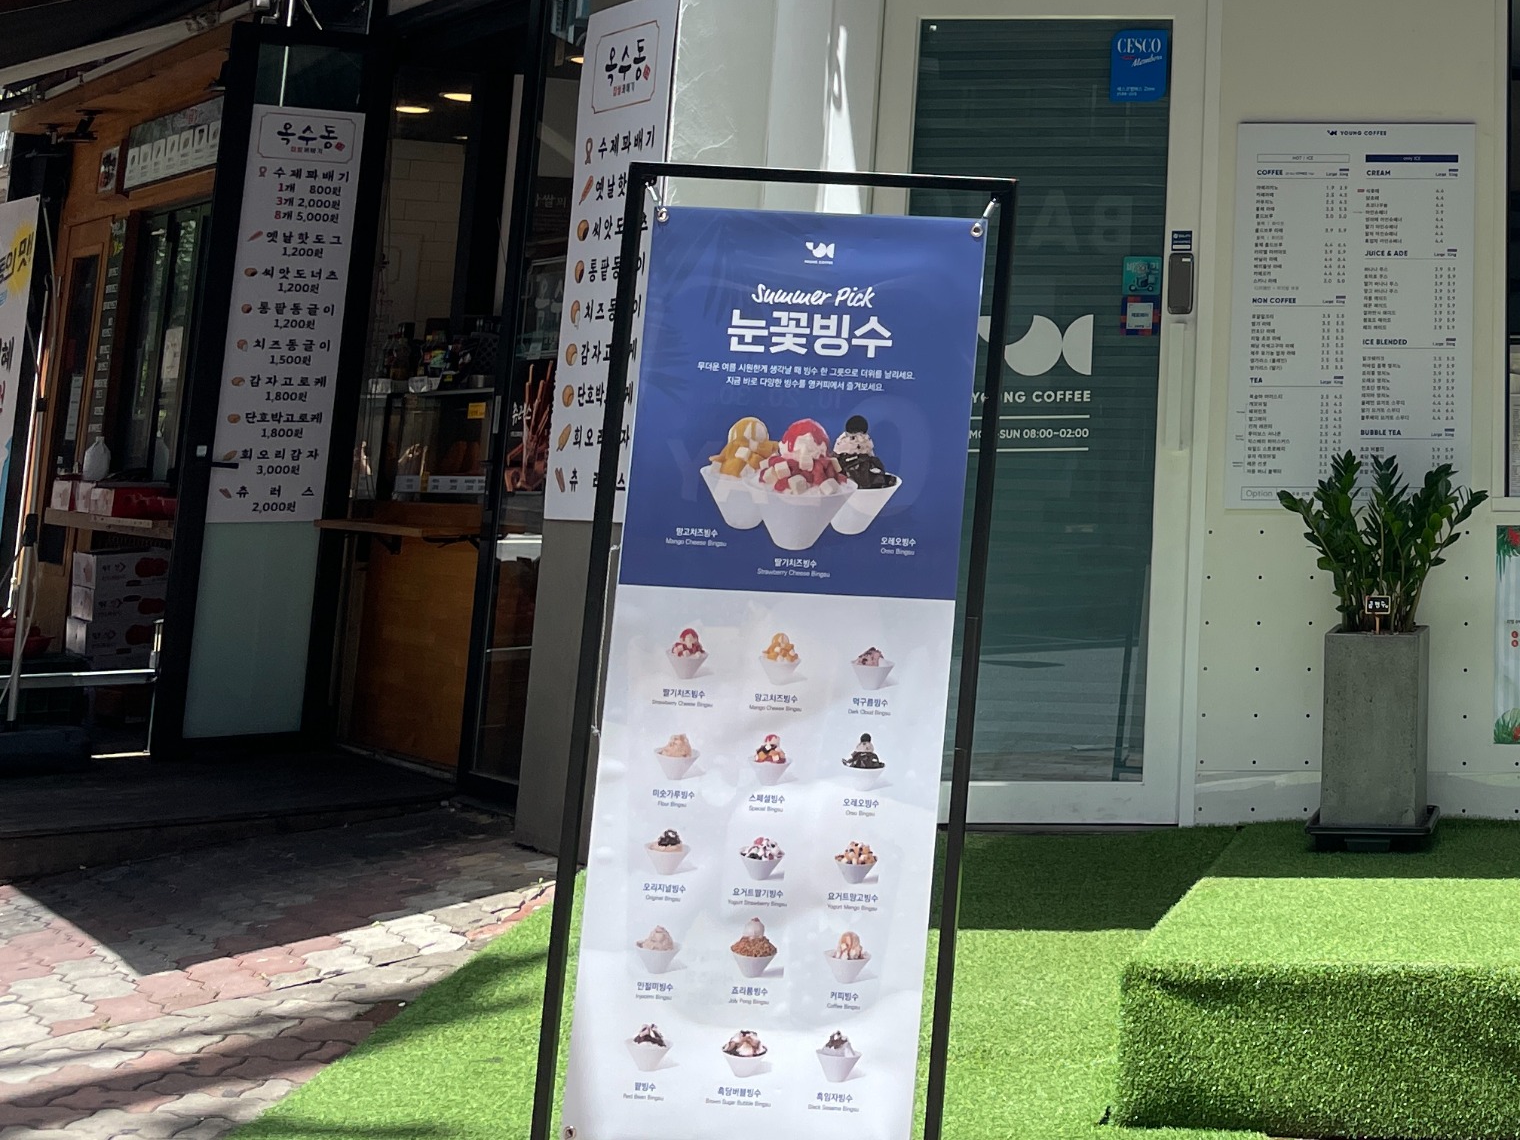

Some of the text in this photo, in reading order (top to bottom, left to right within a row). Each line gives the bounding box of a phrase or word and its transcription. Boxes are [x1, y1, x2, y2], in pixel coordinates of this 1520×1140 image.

[1117, 37, 1162, 54] CESCO
[605, 38, 646, 87] 옥수동
[277, 122, 338, 150] 옥수동
[278, 182, 341, 196] 1개 800원
[276, 196, 340, 210] 3개 2,000원
[274, 210, 339, 224] 8개 5,000원
[266, 230, 343, 245] 옛날핫도그
[282, 246, 323, 259] 1,200원
[261, 266, 339, 281] 씨앗도너츠
[277, 281, 320, 294] 1,200원
[751, 283, 876, 309] Summer Pick
[257, 301, 335, 316] 통팥동글이
[274, 318, 315, 330] 1,200원
[727, 309, 893, 359] 눈꽃빙수
[253, 338, 331, 352] 치즈동글이
[1375, 338, 1408, 346] BLENDED
[269, 354, 311, 366] 1,500원
[804, 366, 859, 377] 빙수 그릇으로
[249, 374, 327, 388] 감자고로케
[265, 390, 307, 403] 1,800원
[1032, 390, 1091, 403] COFFEE
[245, 411, 323, 425] 단호박고로케
[260, 427, 303, 439] 1,800원
[240, 447, 319, 462] 회오리감자
[256, 464, 300, 476] 3,000원
[1245, 489, 1273, 498] Option
[251, 501, 296, 514] 2,000원
[676, 527, 718, 538] 망고치즈빙수
[880, 536, 916, 548] 오레오빙수
[774, 558, 817, 569] 딸기치즈빙수
[662, 688, 706, 699] 딸기치즈빙수
[754, 692, 798, 704] 망고치즈빙수
[652, 788, 695, 800] 미숫가루빙수
[748, 794, 785, 805] 스페셜빙수
[843, 798, 880, 809] 오레오빙수
[643, 882, 686, 894] 오리지널빙수
[732, 887, 784, 899] 요거트딸기빙수
[827, 891, 879, 903] 요거트망고빙수
[637, 981, 673, 992] 인절미빙수
[830, 991, 859, 1002] 커피빙수
[634, 1082, 656, 1092] 팥빙수
